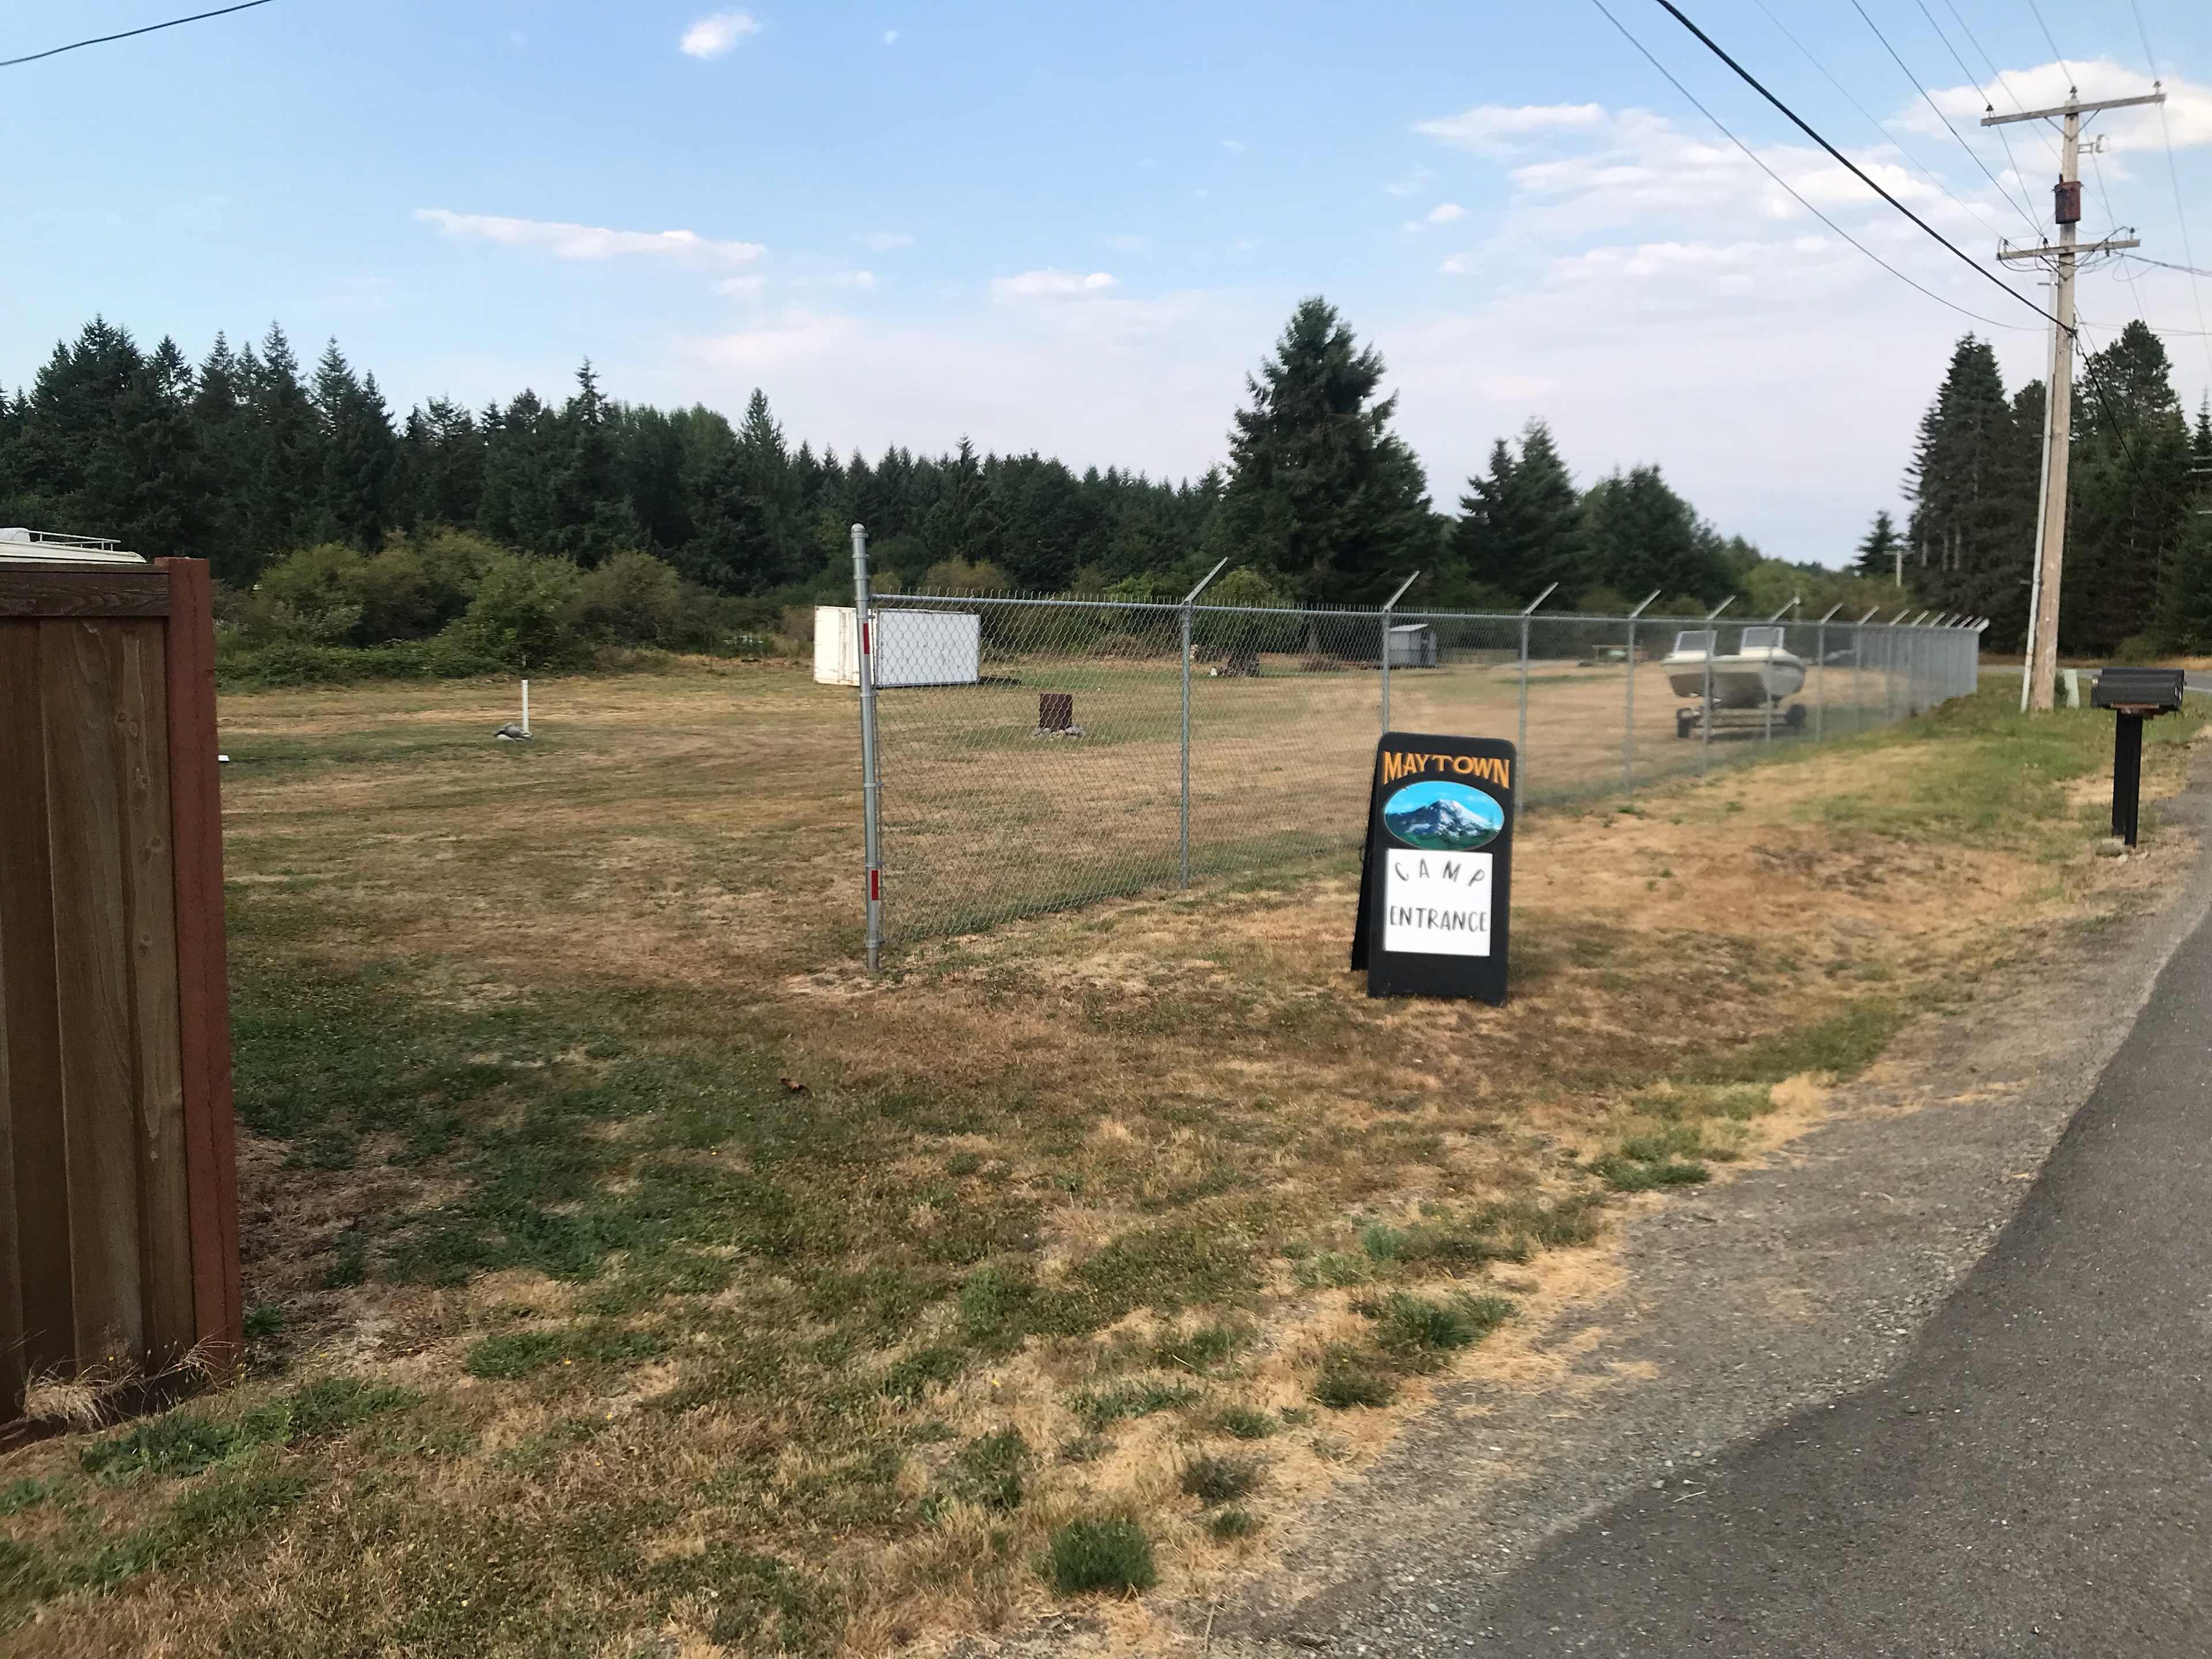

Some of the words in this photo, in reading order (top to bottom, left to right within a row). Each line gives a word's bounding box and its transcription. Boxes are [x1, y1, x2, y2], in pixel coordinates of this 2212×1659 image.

[1384, 751, 1510, 789] MAYTOWN
[1395, 858, 1486, 887] CAMP
[1390, 905, 1488, 932] ENTRANCE
